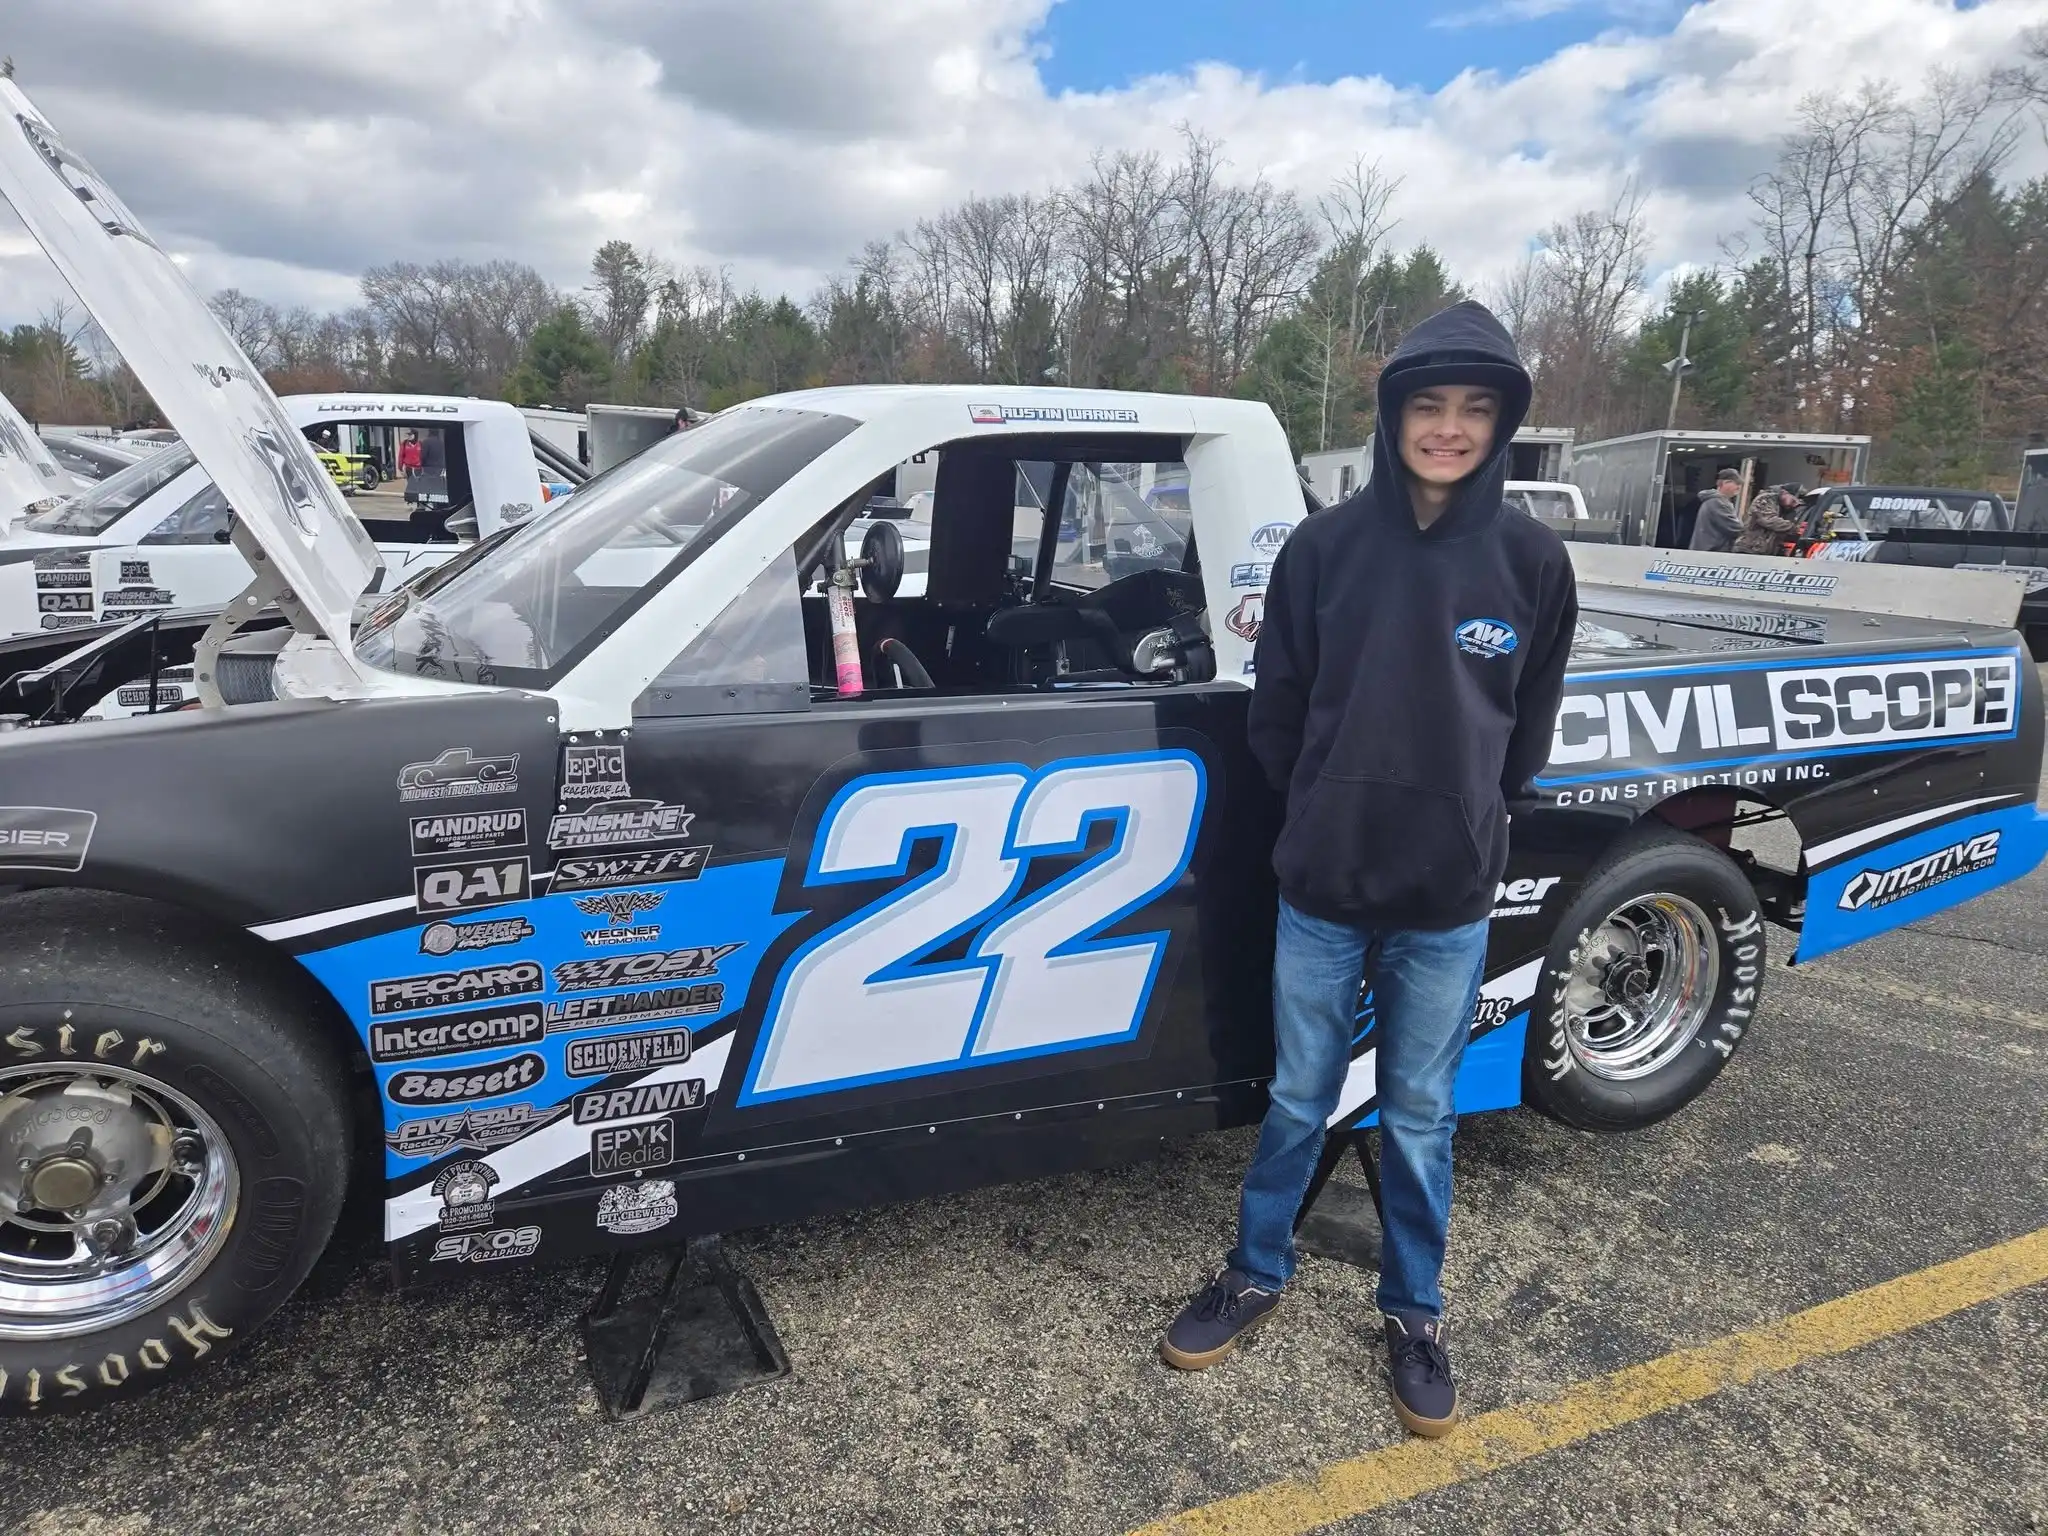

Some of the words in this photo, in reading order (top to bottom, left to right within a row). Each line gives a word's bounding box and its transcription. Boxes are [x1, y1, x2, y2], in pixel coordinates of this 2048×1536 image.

[1001, 407, 1064, 421] AUSTIN
[1066, 408, 1139, 423] WARNER
[1869, 496, 1931, 512] BROWN
[37, 573, 90, 583] GANDRUD
[1651, 560, 1838, 589] MonarchWorld.com
[40, 594, 91, 611] QA1
[1457, 621, 1514, 647] AW
[121, 688, 179, 704] SCHOEFELD
[1547, 684, 1770, 766] CIVIL
[1784, 665, 2010, 741] SCOPE
[568, 755, 622, 776] EPIC
[1556, 768, 1777, 807] CONSTRUCTION
[1786, 763, 1831, 781] INC.
[415, 812, 522, 839] GANDRUD
[552, 808, 680, 840] FINISHLINE
[562, 829, 650, 846] TOWING
[423, 863, 523, 907] QA1
[581, 926, 661, 940] WEGNER
[585, 935, 658, 947] AUTOMOTIVE
[740, 752, 1205, 1104] 22
[599, 943, 738, 978] TOBY
[375, 965, 539, 1003] PECARO
[562, 979, 612, 991] RACE
[614, 968, 705, 986] PRODUCTS
[376, 980, 540, 1012] MOTORSPORTS
[547, 983, 725, 1023] LEFTHANDER
[573, 1006, 698, 1027] PERFORMANCE
[375, 1013, 540, 1052] Intercomp
[573, 1033, 684, 1069] SCHOENFELD
[399, 1058, 535, 1099] Bassett
[578, 1081, 698, 1123] BRINN
[400, 1116, 460, 1140] FIVE
[470, 1105, 531, 1125] STAR
[480, 1125, 522, 1138] Bodies
[597, 1124, 669, 1151] EPYK
[597, 1144, 666, 1170] Media
[449, 1202, 492, 1217] PROMOTIONS
[600, 1213, 619, 1223] PIT
[620, 1209, 652, 1221] CREW
[653, 1205, 676, 1216] BBQ
[473, 1244, 534, 1260] GRAPHICS
